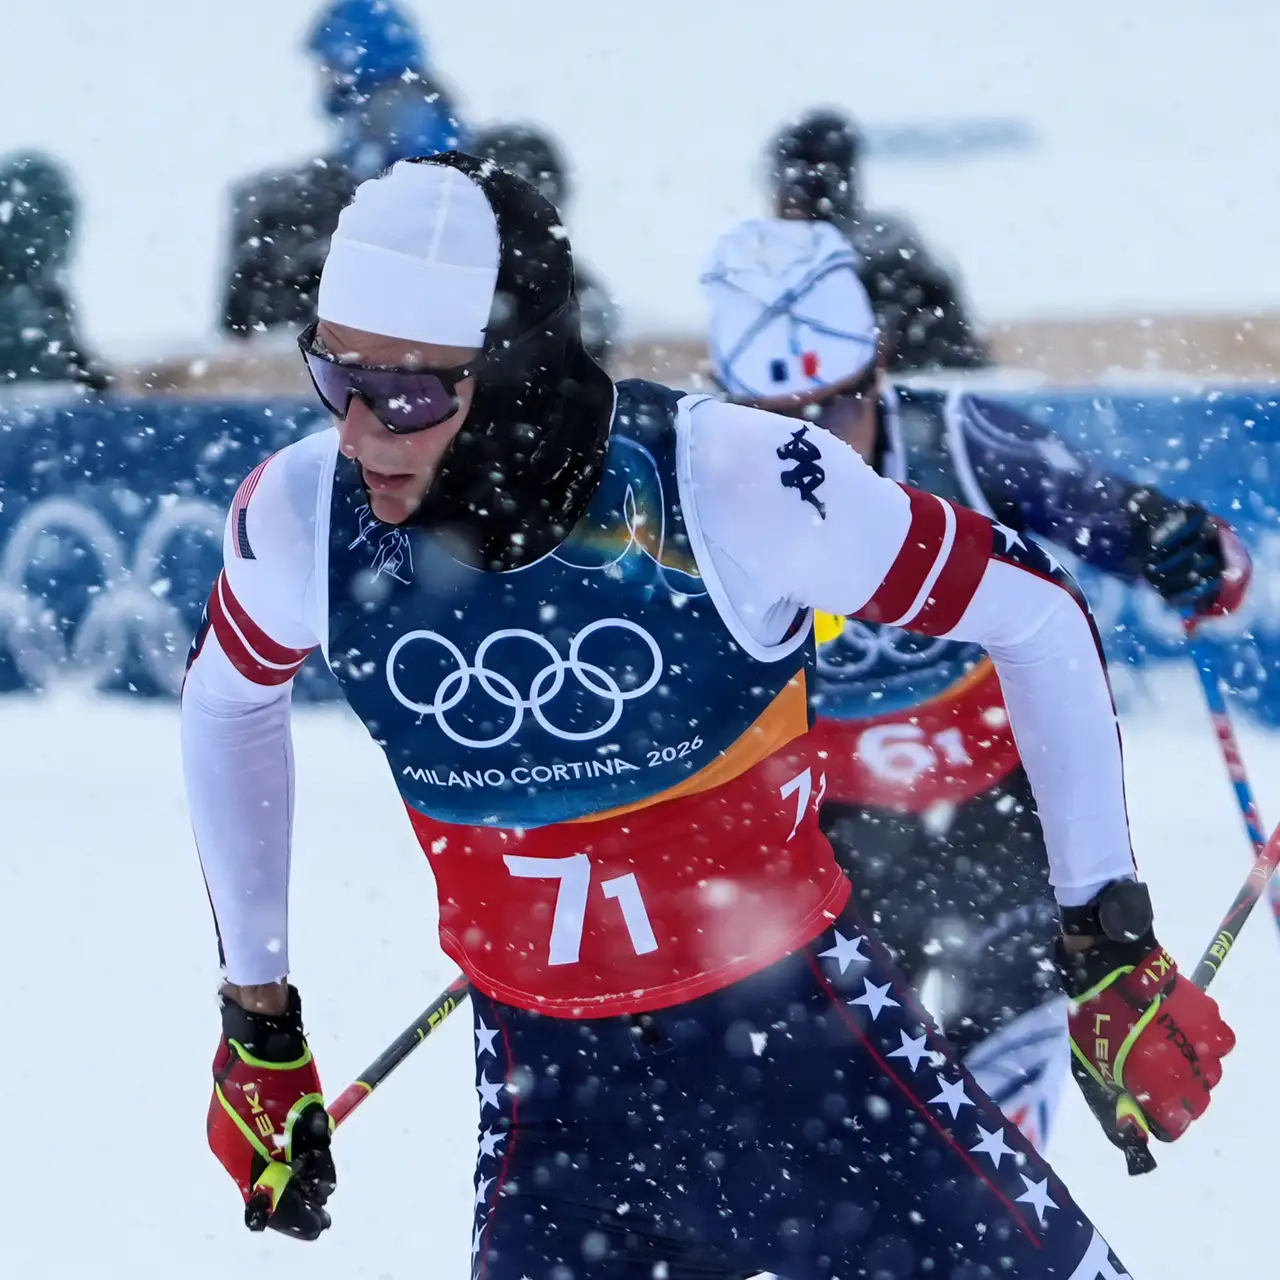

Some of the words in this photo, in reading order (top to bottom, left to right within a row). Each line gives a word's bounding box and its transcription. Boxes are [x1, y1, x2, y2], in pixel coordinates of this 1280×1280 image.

[403, 765, 505, 788] MILANO
[510, 757, 641, 785] CORTINA
[646, 735, 704, 767] 2026
[857, 723, 974, 785] 61
[502, 853, 659, 966] 71
